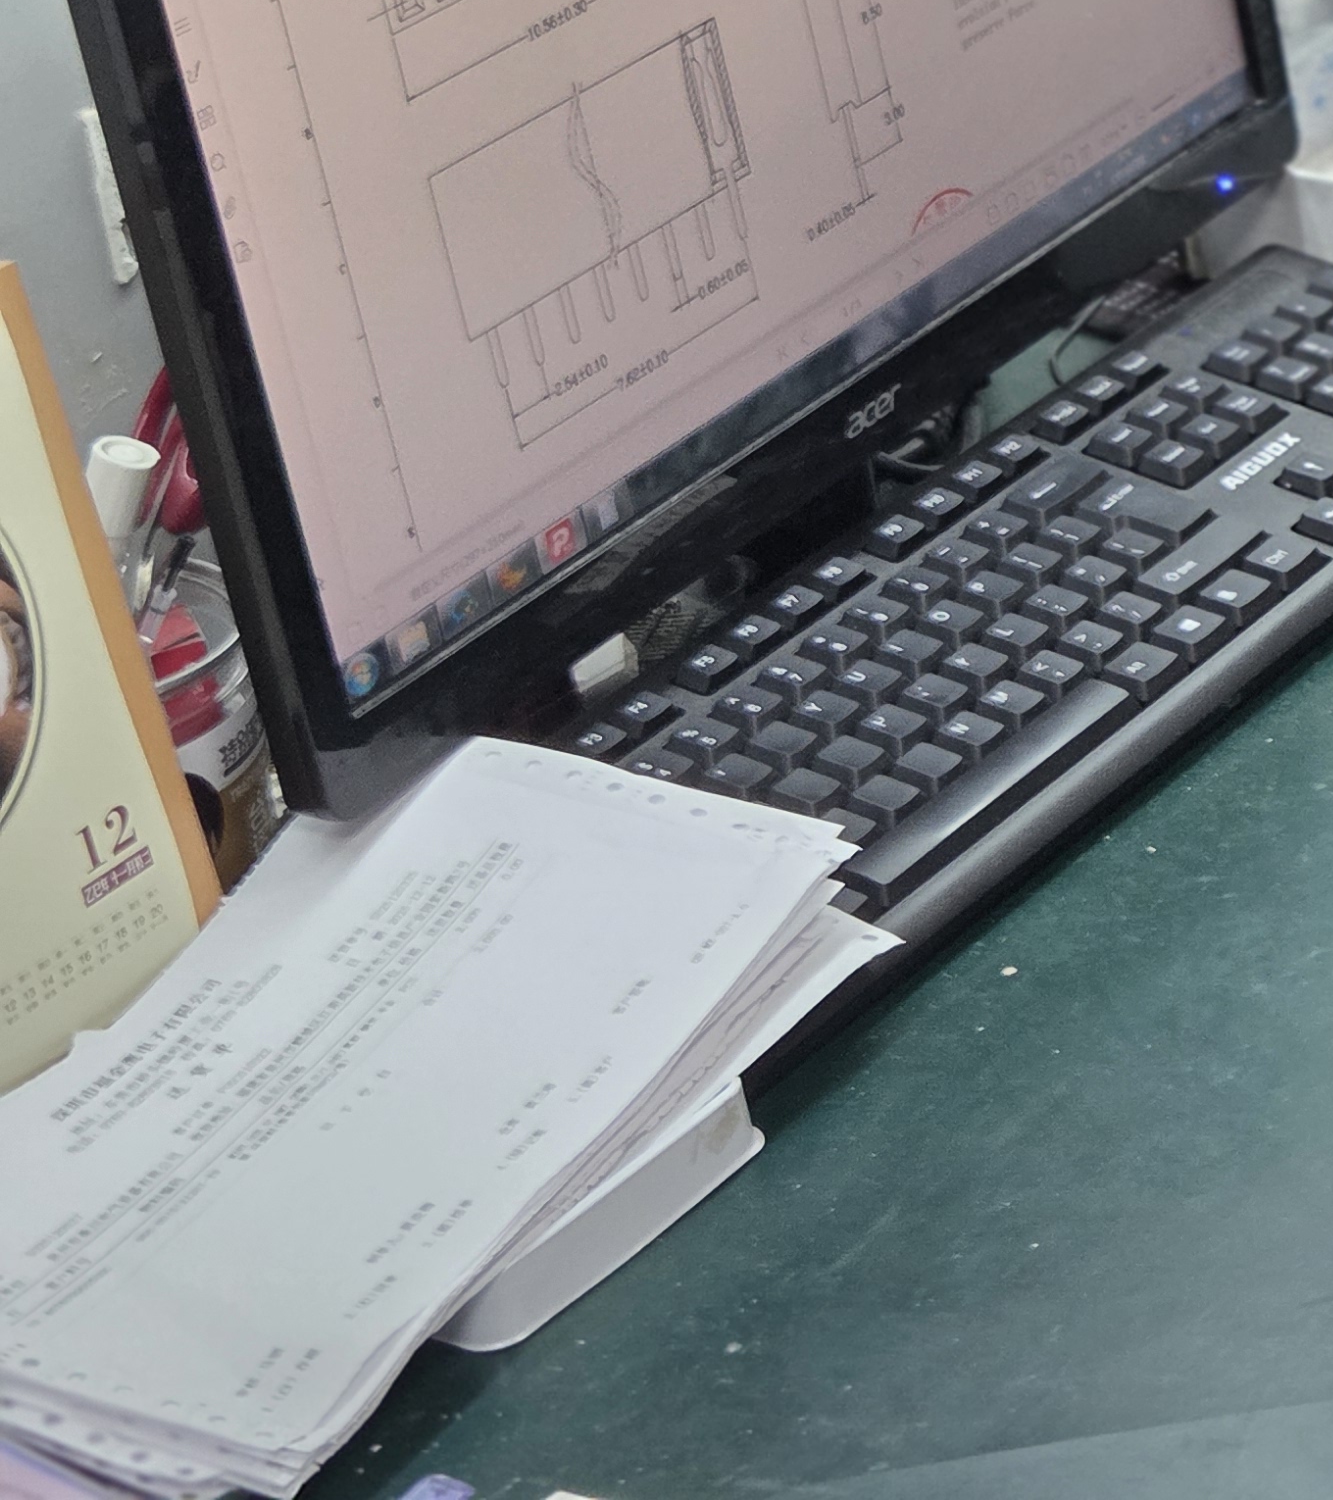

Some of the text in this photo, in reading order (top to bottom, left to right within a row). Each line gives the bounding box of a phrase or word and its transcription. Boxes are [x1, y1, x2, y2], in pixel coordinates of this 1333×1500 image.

[861, 3, 883, 25] 8.50
[884, 104, 906, 126] 3.00
[699, 259, 751, 300] 0.60±0.05
[617, 350, 669, 392] 7.62±0.10
[845, 383, 902, 440] acer
[1220, 434, 1300, 491] AIGUOX
[75, 805, 138, 875] 12
[22, 987, 37, 1000] 13
[41, 975, 55, 988] 14
[60, 963, 74, 976] 15
[78, 951, 92, 964] 16
[97, 938, 110, 952] 17
[115, 927, 128, 940] 18
[132, 915, 146, 929] 19
[150, 903, 164, 919] 20
